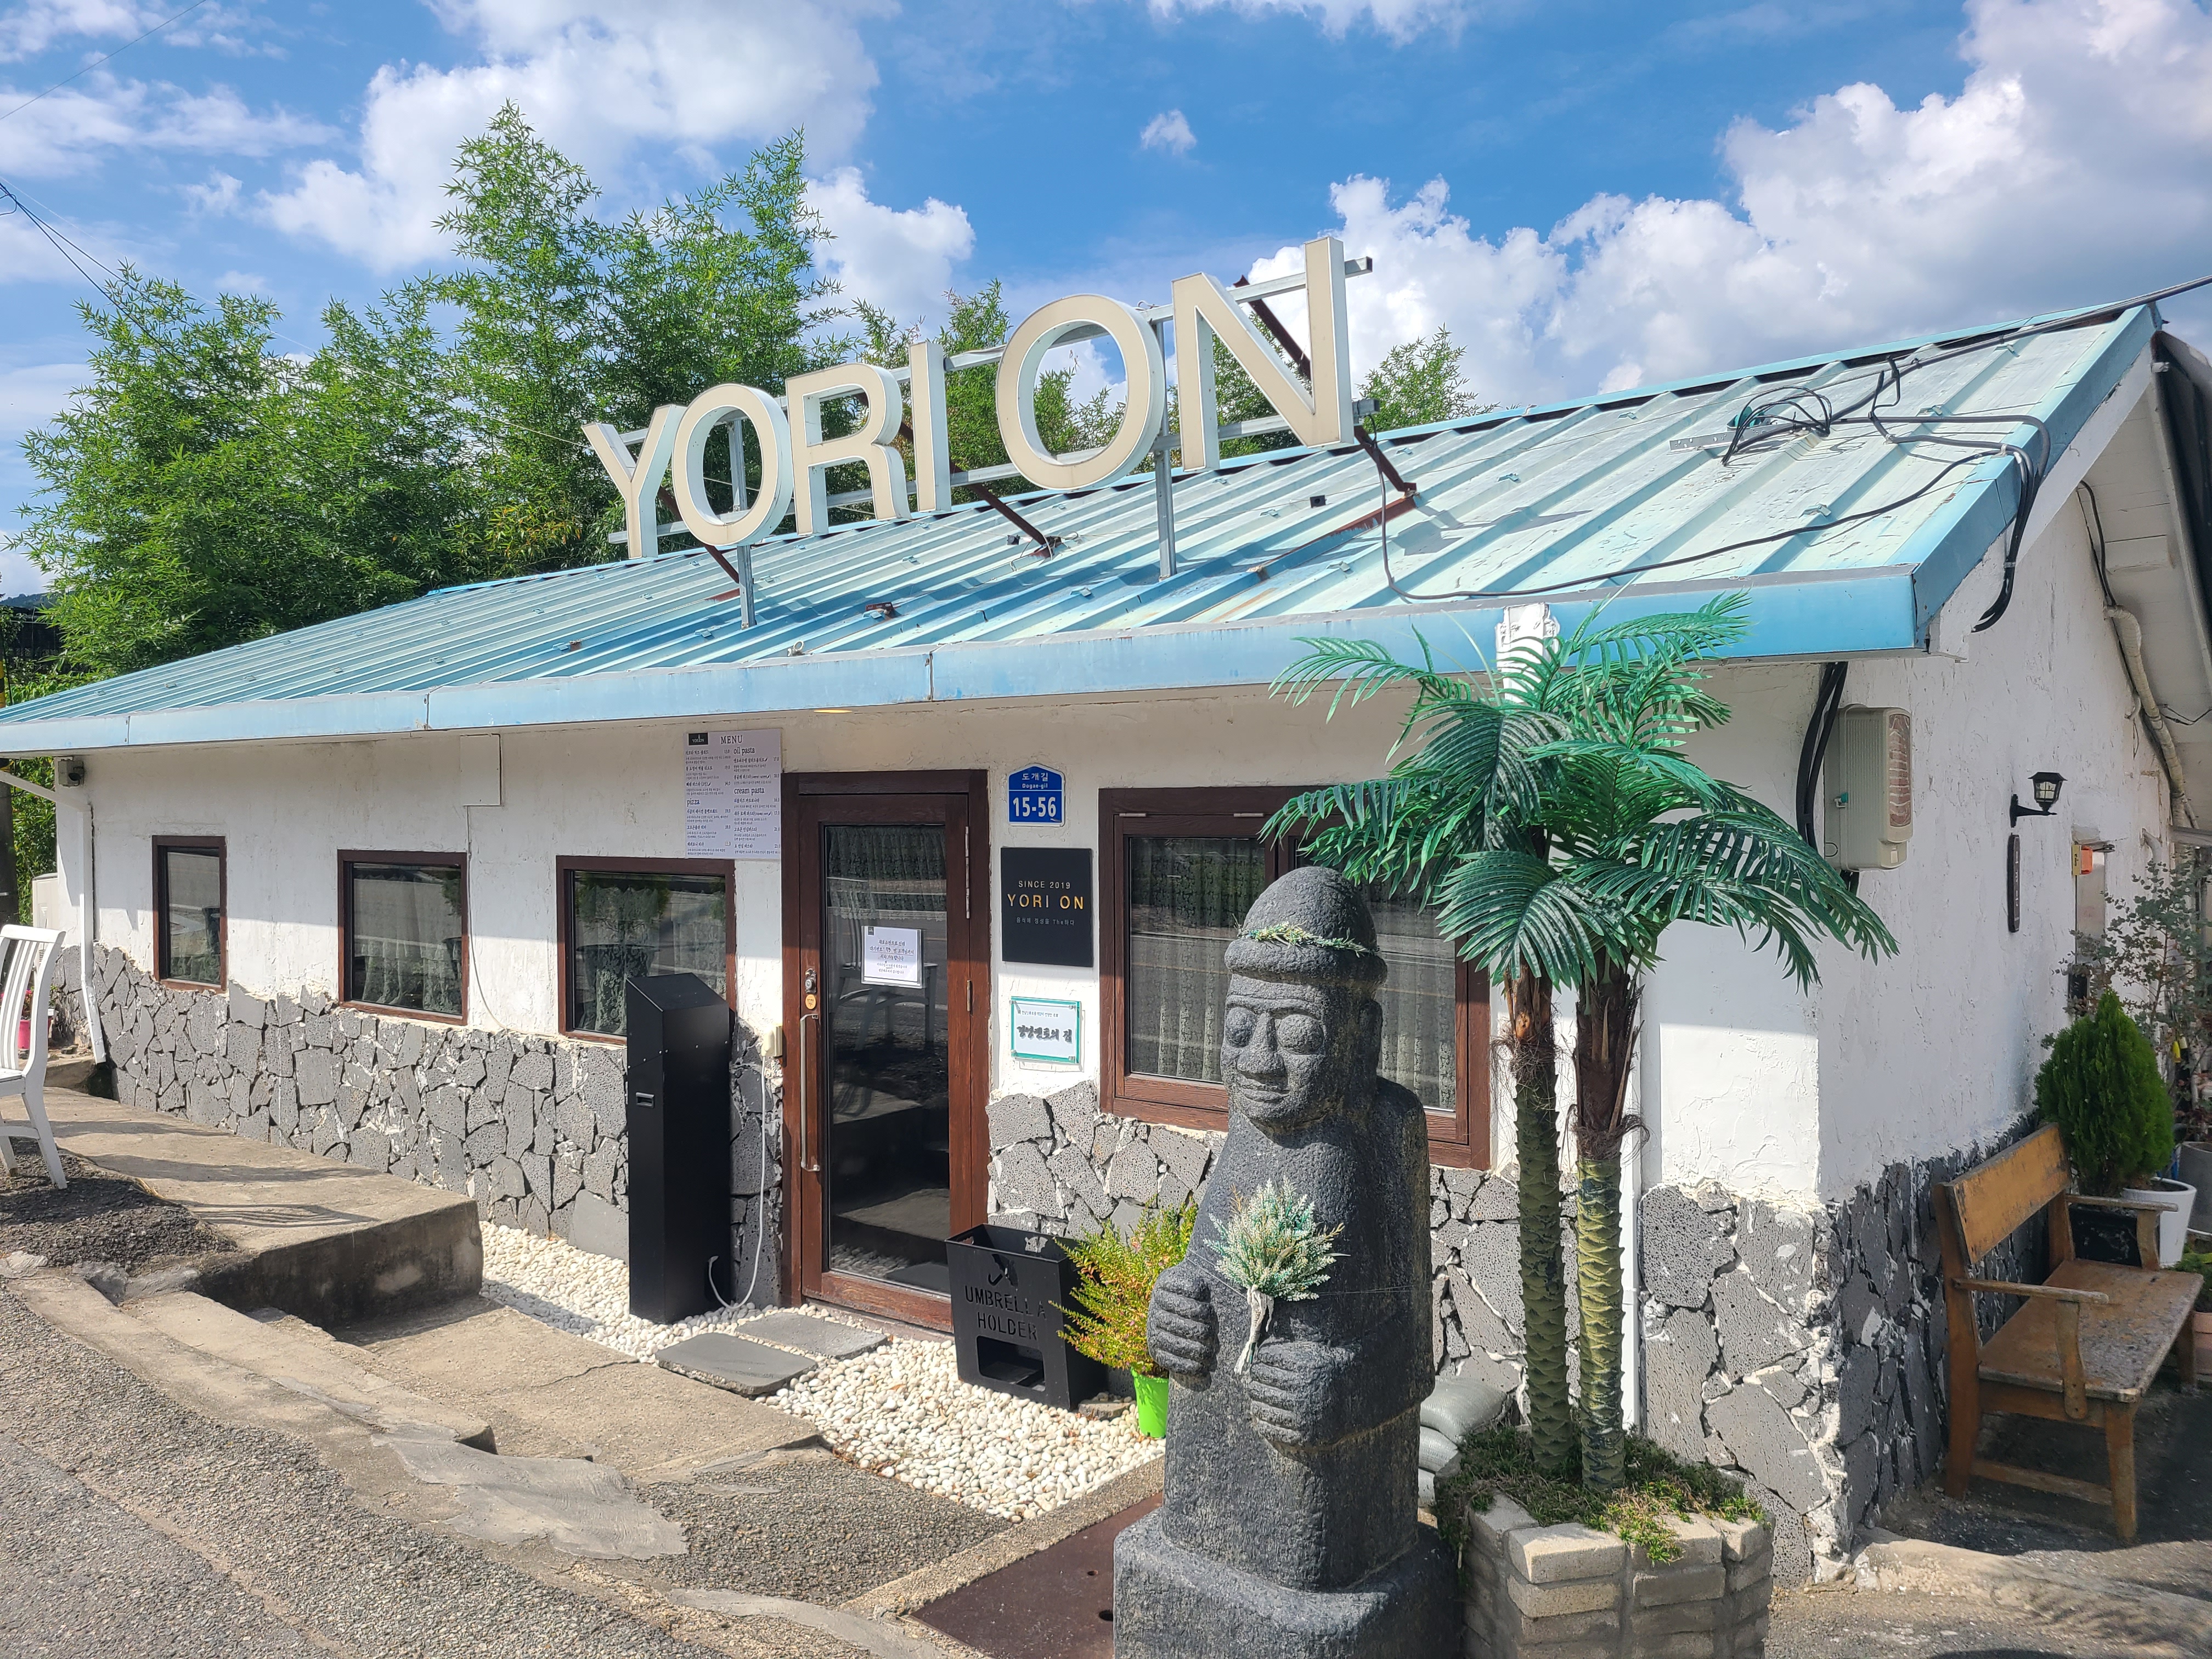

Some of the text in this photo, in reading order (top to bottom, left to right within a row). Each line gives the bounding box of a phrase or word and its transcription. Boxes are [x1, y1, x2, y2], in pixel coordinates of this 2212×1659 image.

[582, 236, 1353, 558] YORI ON
[720, 735, 743, 744] MENU
[742, 747, 755, 756] pasta
[1022, 772, 1048, 782] 도개길
[751, 787, 765, 796] pasta
[687, 798, 700, 808] pizza
[1013, 797, 1056, 817] 15-56
[1018, 880, 1070, 889] SINCE 2019
[1007, 894, 1084, 910] YORI ON
[1062, 1029, 1072, 1043] 집
[964, 1285, 1047, 1340] UMBRELLA HOLDER
